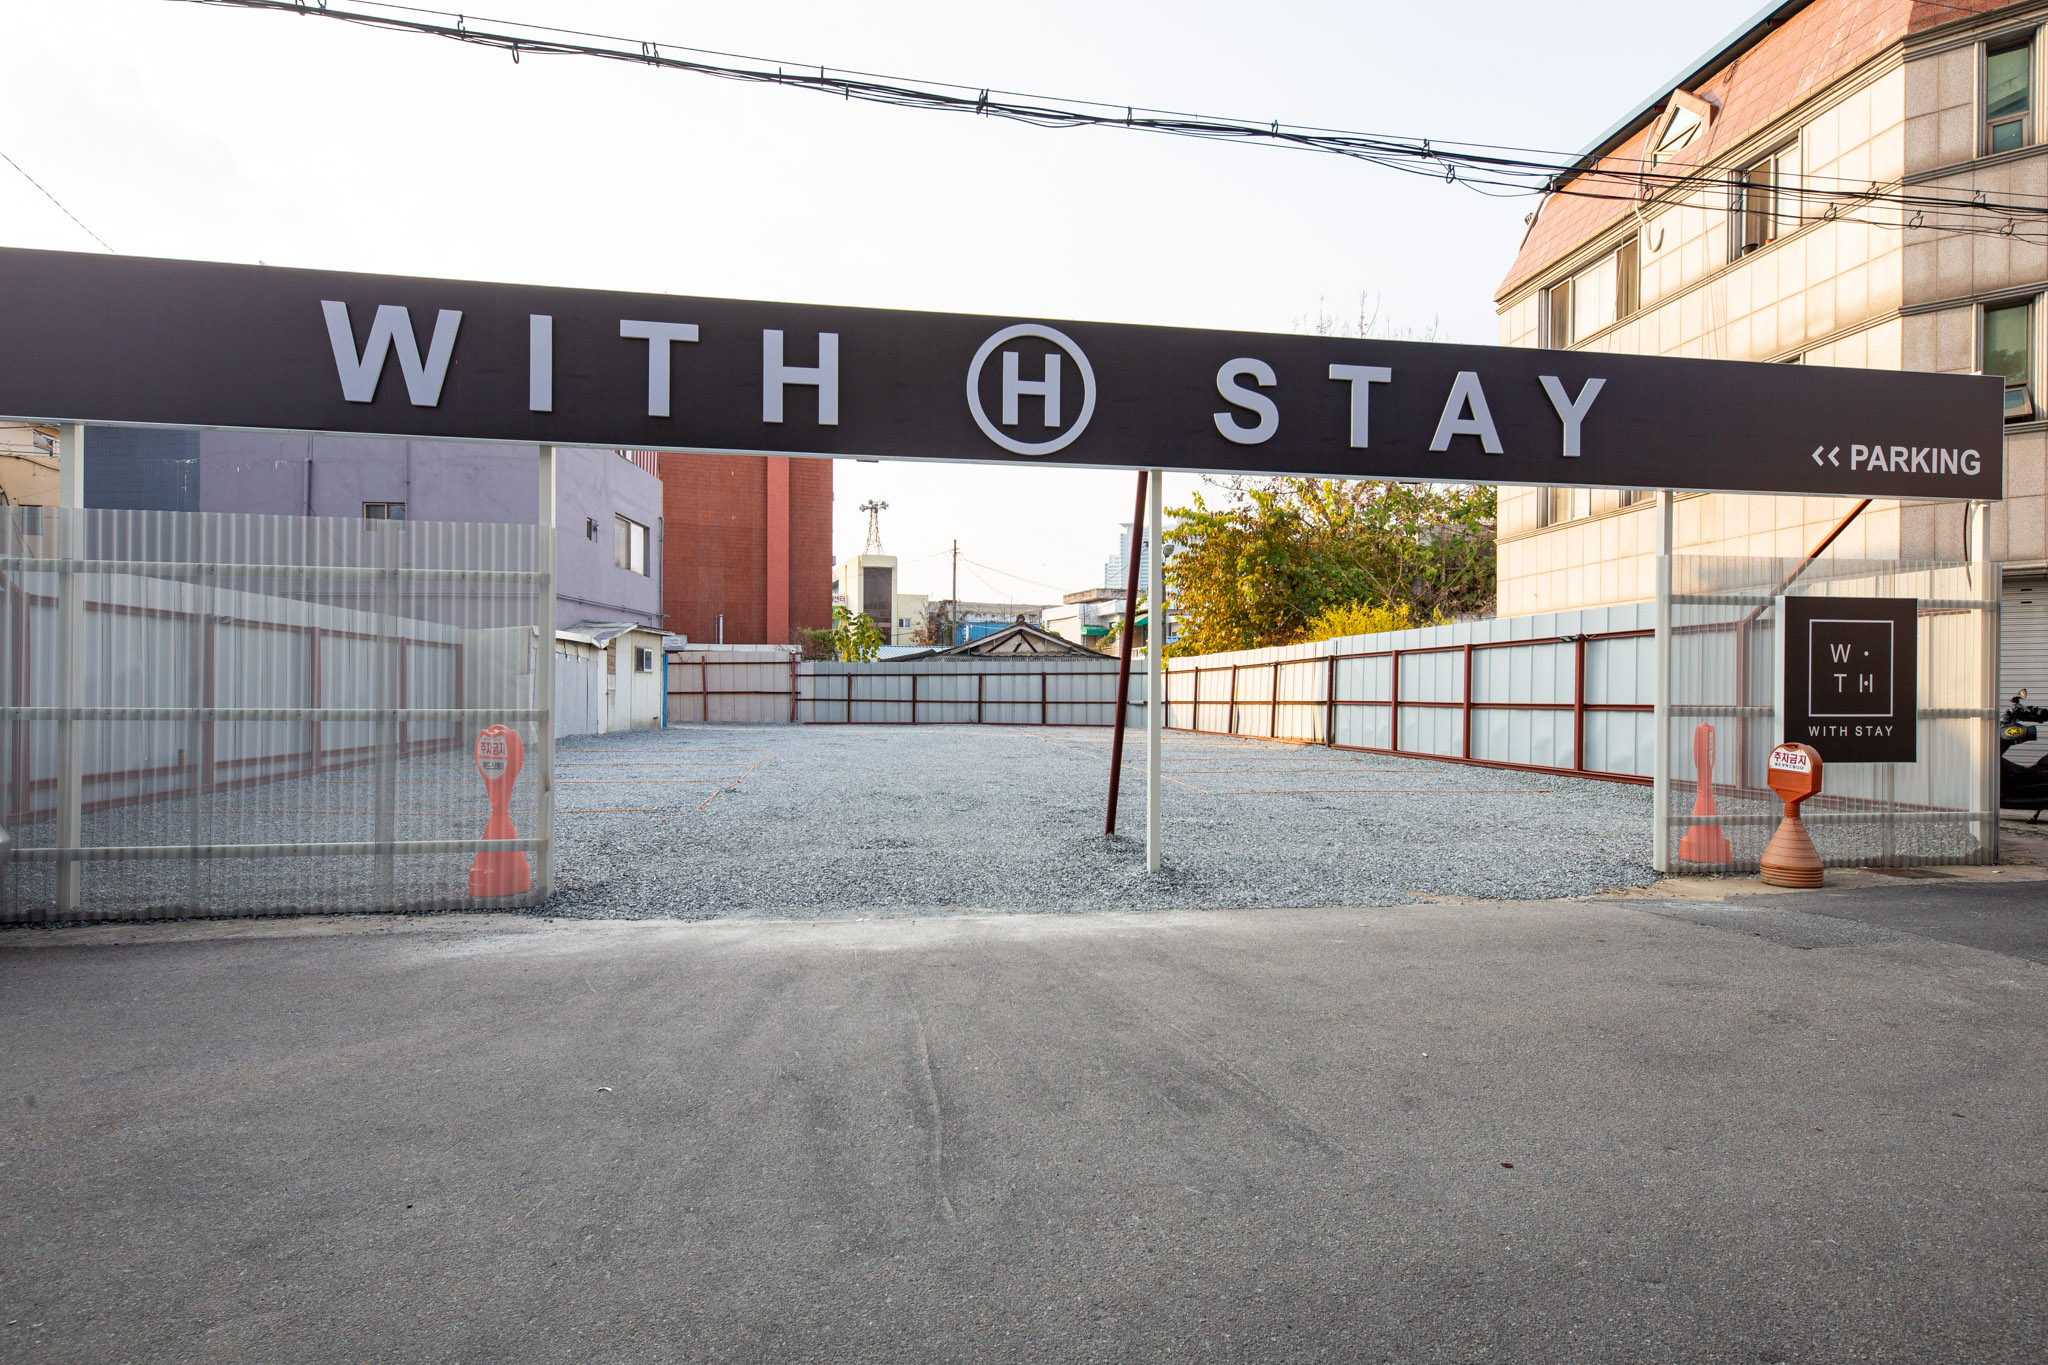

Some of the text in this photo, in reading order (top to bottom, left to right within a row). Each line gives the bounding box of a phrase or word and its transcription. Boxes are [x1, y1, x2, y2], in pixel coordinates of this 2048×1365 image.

[321, 300, 839, 426] WITH
[1213, 357, 1607, 457] STAY
[1850, 444, 1981, 476] PARKING
[1808, 725, 1893, 737] WITH STAY
[480, 741, 506, 756] 주차금지
